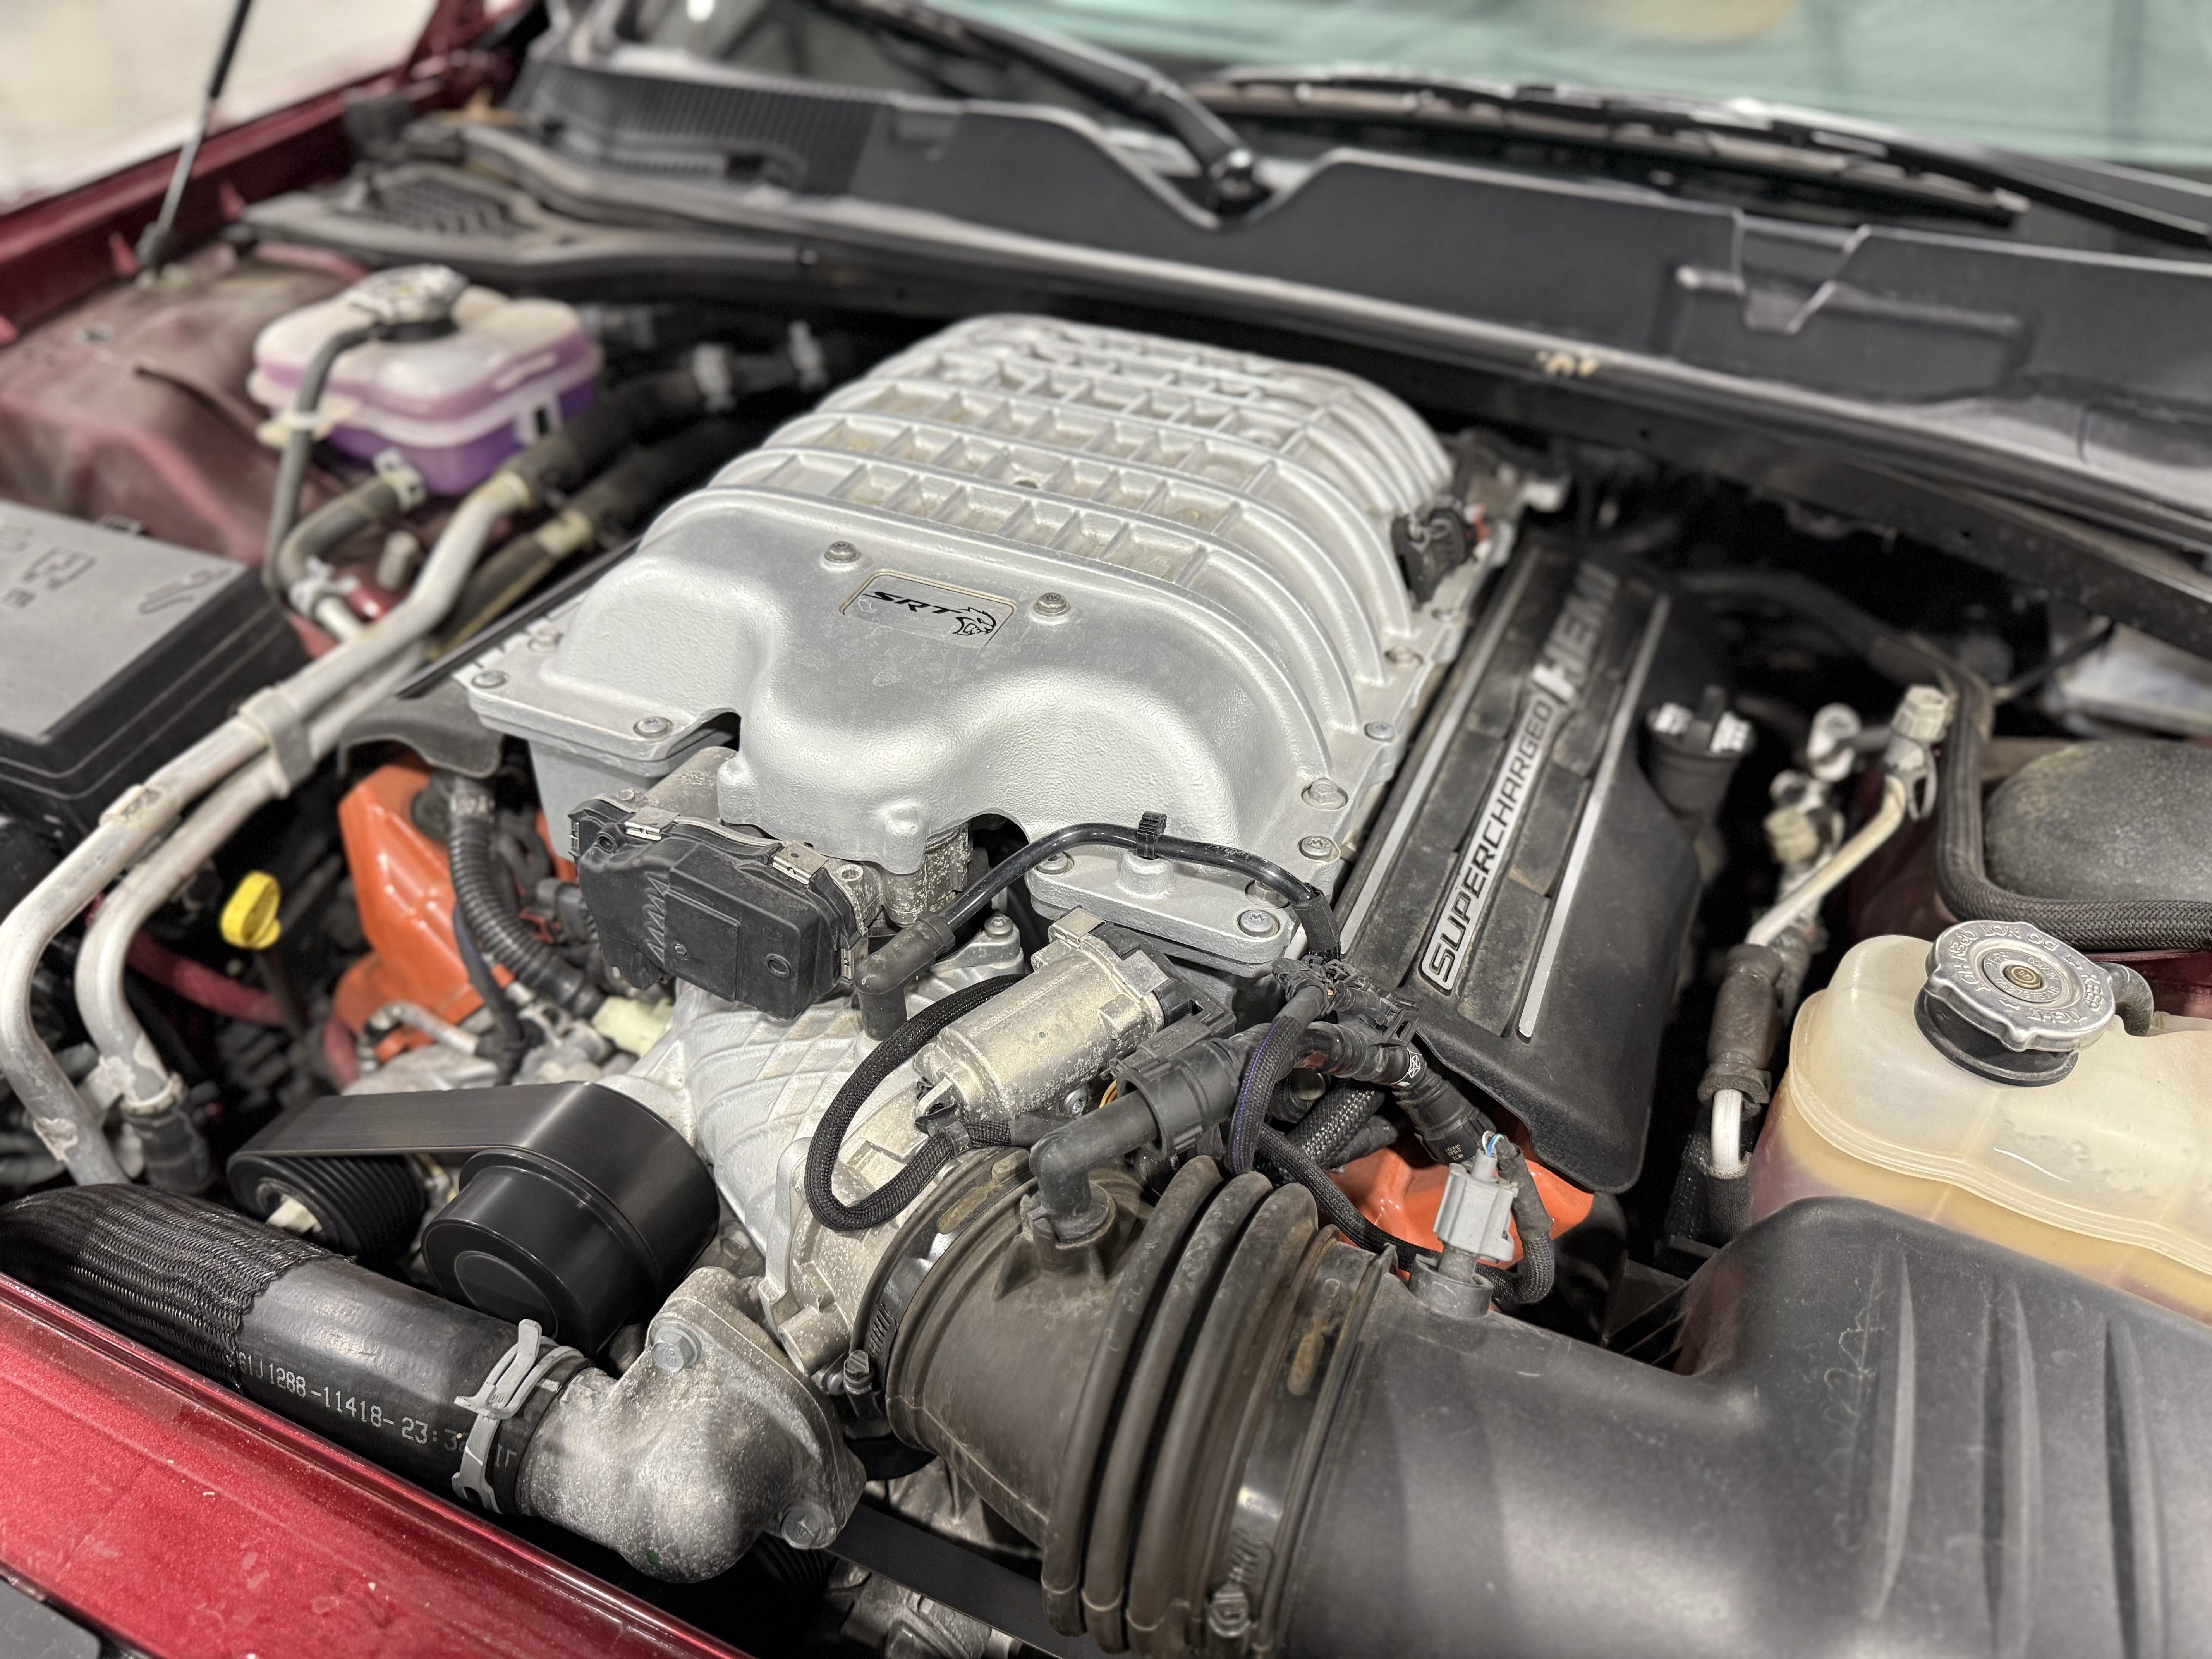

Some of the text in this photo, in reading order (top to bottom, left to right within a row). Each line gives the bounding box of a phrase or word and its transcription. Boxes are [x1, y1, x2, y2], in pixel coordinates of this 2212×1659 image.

[862, 591, 963, 614] SRT
[1428, 699, 1552, 983] SUPERCHARGED
[1979, 924, 2021, 939] NOT
[2027, 933, 2059, 952] DO
[1948, 929, 1978, 961] OPEN
[1953, 965, 1991, 992] HOT
[2028, 957, 2059, 980] MEXICO
[2027, 974, 2104, 1026] KEEP TIGHT
